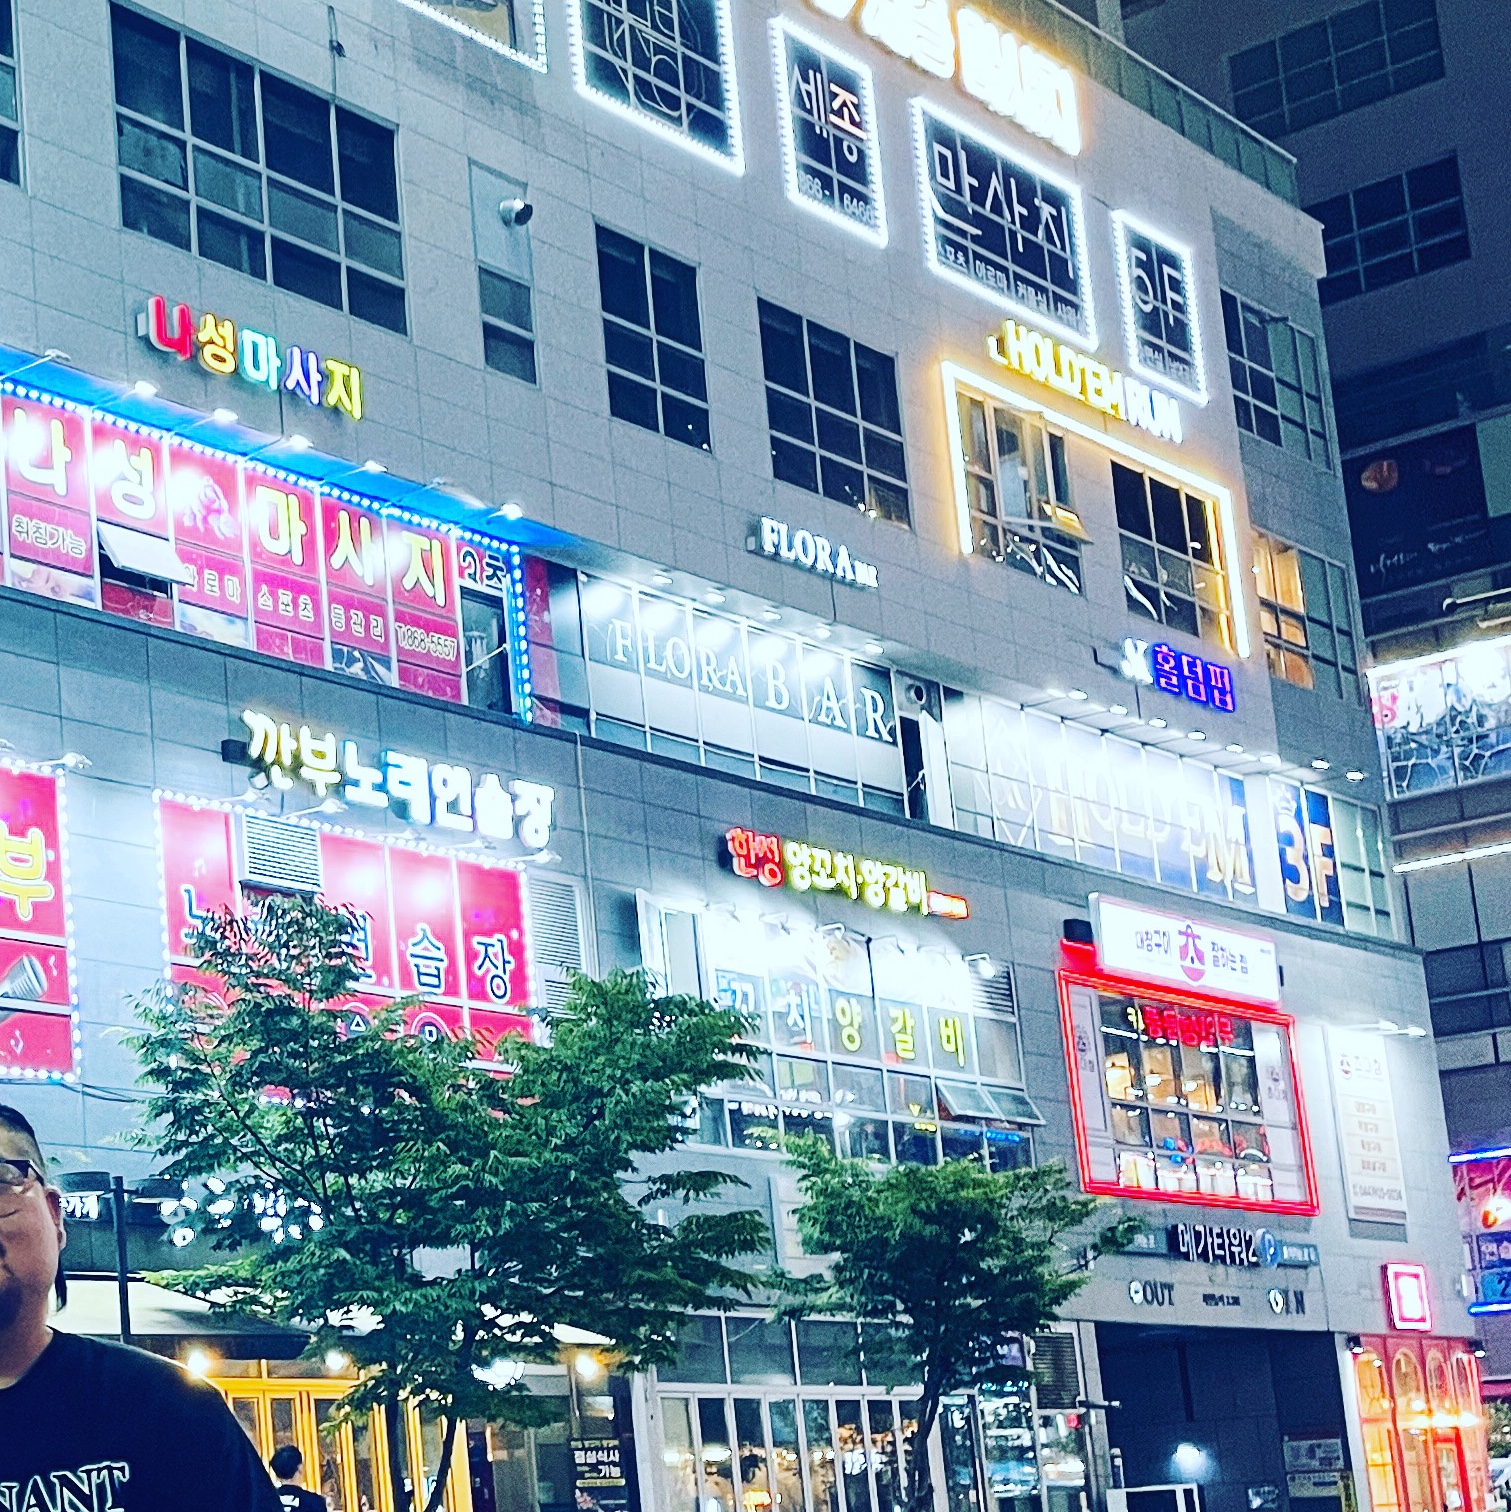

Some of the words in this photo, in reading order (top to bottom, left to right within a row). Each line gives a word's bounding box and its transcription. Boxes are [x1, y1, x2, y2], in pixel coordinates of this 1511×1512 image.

[789, 63, 870, 164] 세종
[1128, 246, 1184, 328] 5F
[12, 512, 87, 559] 취침가능
[760, 515, 851, 578] FLORA
[257, 581, 316, 625] 스포츠
[606, 618, 748, 697] FLORA
[763, 660, 896, 743] BAR
[1155, 643, 1236, 713] 홀덤펍
[726, 827, 784, 887] 한성
[1276, 812, 1336, 910] 3F
[1135, 928, 1172, 962] 대창구이
[834, 996, 966, 1069] 양갈비
[1177, 1223, 1258, 1266] 메가타워2
[1143, 1280, 1175, 1306] OUT
